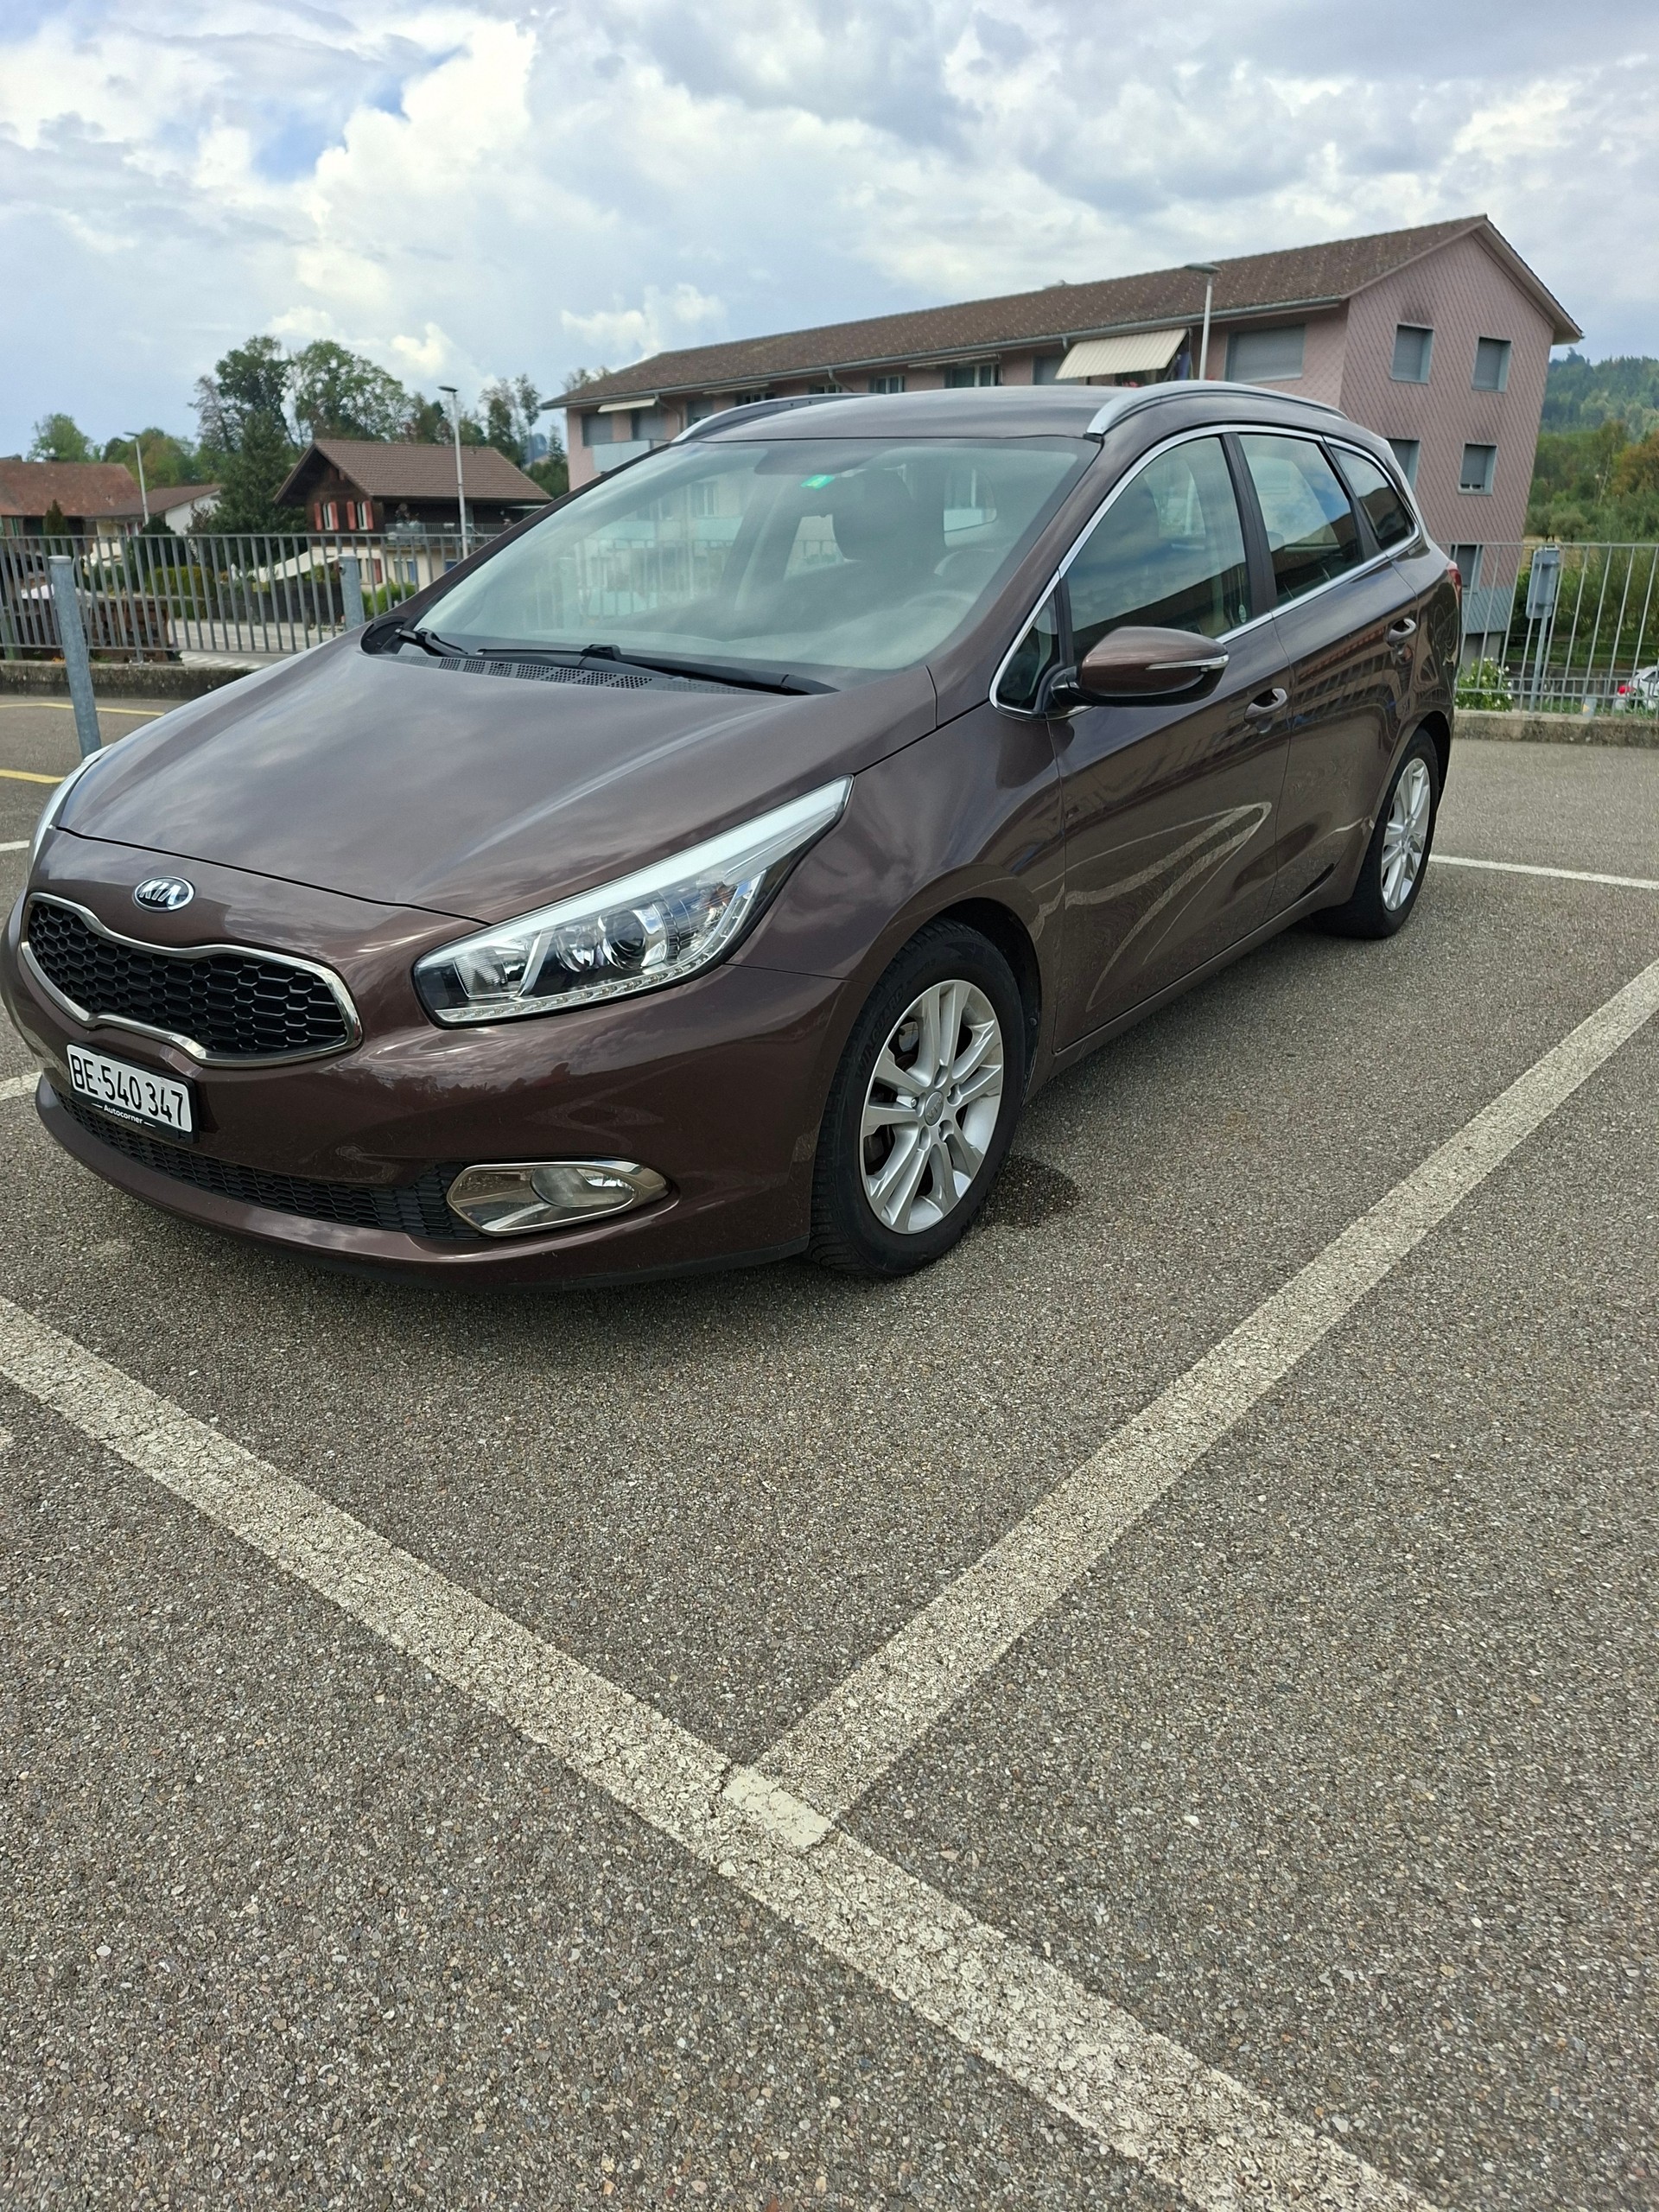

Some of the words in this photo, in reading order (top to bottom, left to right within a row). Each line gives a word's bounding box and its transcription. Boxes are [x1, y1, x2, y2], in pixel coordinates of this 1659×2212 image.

[138, 880, 181, 906] KIA
[103, 1104, 143, 1124] Autocorner
[145, 1082, 182, 1127] 347
